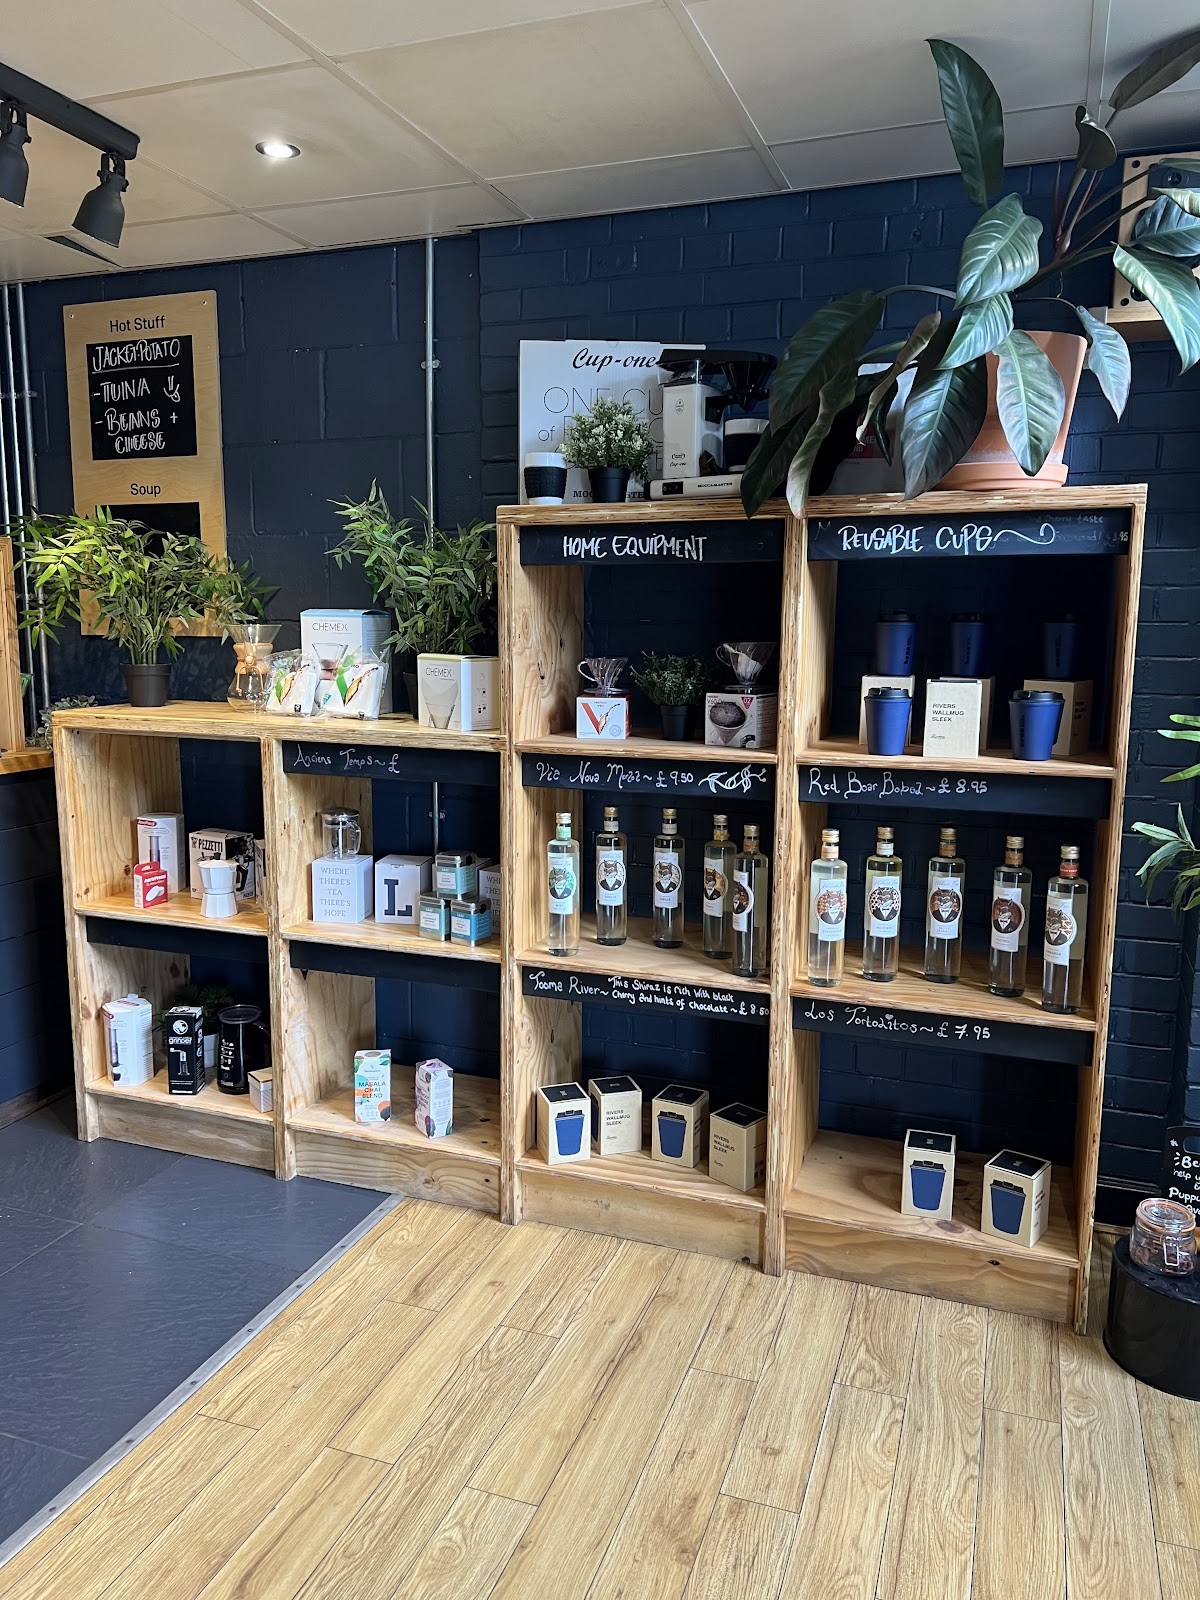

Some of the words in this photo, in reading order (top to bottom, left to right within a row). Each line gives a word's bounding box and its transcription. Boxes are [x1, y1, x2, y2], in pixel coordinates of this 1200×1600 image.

[110, 320, 130, 332] Hot
[134, 316, 166, 330] Stuff
[538, 426, 555, 442] of
[115, 432, 166, 454] CHEESE
[130, 484, 162, 498] Soup
[563, 536, 608, 558] HOME
[612, 533, 707, 561] EQUIPMENT
[935, 524, 992, 554] CUPS
[312, 622, 348, 631] CHEMEX
[426, 668, 452, 677] CHEMEX
[536, 762, 560, 781] Via
[570, 760, 600, 784] Nova
[808, 768, 840, 796] Red
[844, 771, 878, 799] Boar
[198, 838, 223, 852] PEZZETTI
[319, 878, 351, 886] THERE'S
[328, 888, 342, 896] TEA
[384, 878, 412, 916] L
[320, 899, 351, 907] THERE'S
[568, 976, 600, 994] River
[608, 976, 628, 988] This
[632, 979, 660, 992] Shiraz
[664, 984, 672, 994] is
[674, 987, 691, 996] rich
[712, 992, 734, 1002] black
[638, 992, 652, 1003] and
[676, 999, 686, 1010] of
[804, 1002, 834, 1022] Los
[1173, 1168, 1192, 1180] help
